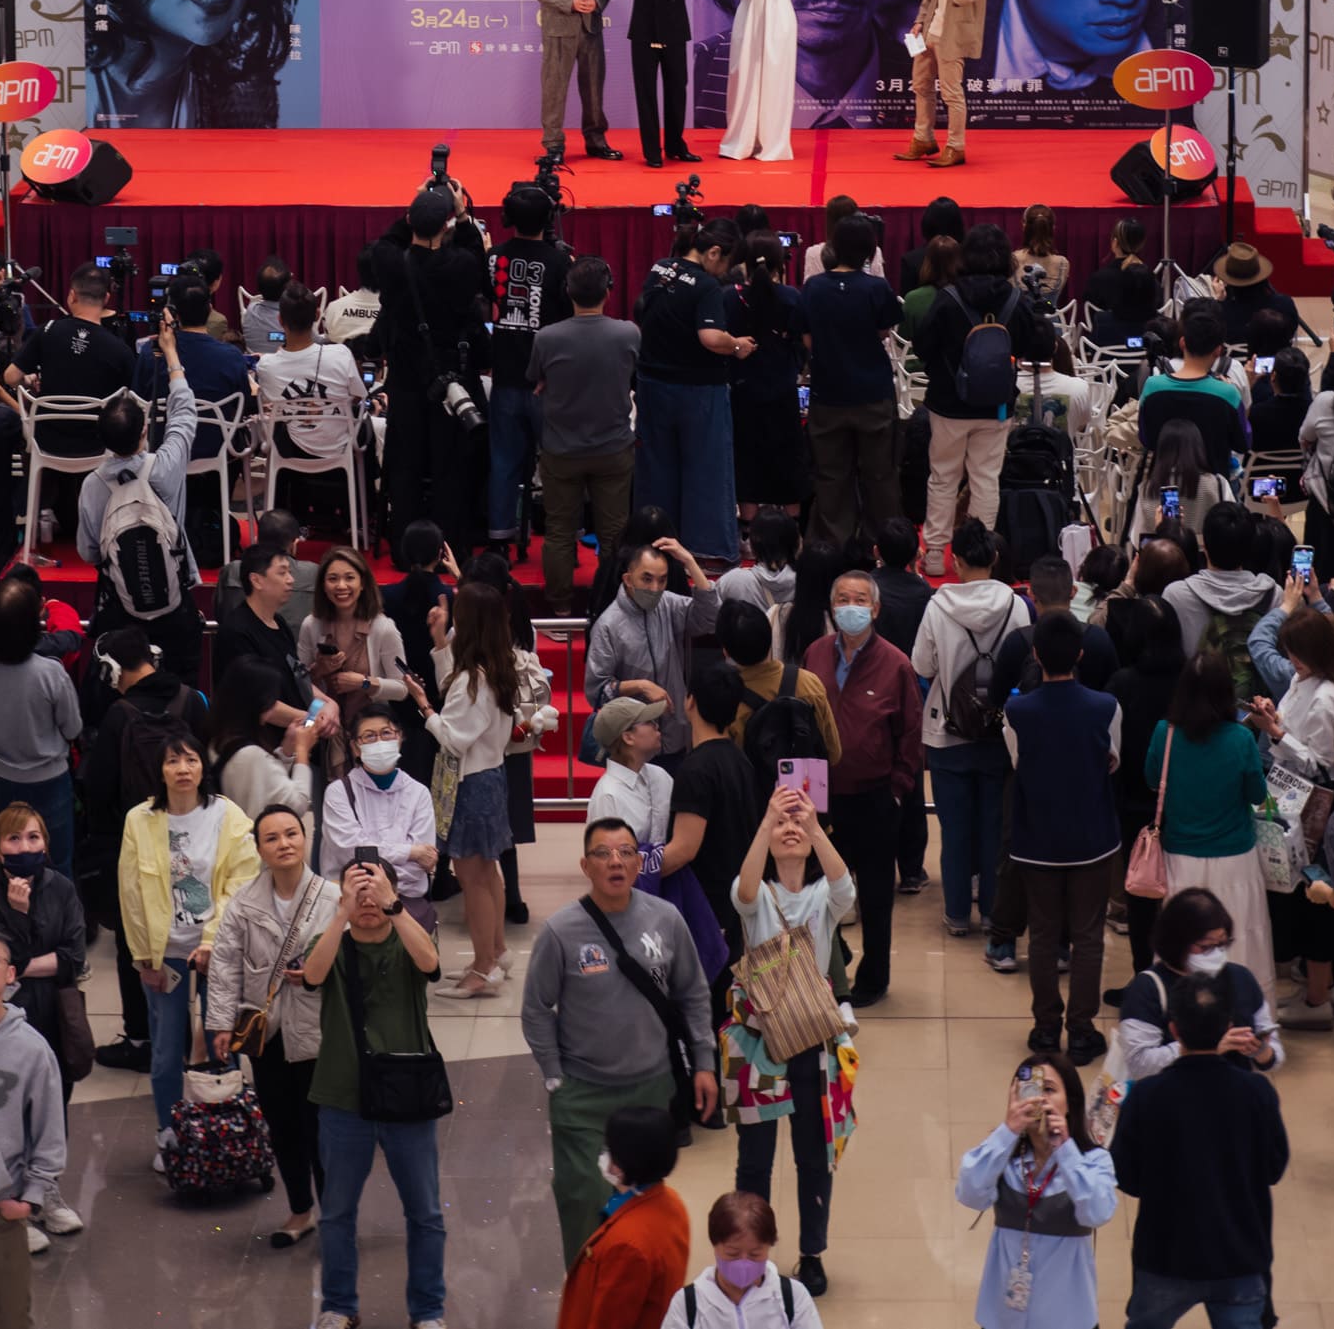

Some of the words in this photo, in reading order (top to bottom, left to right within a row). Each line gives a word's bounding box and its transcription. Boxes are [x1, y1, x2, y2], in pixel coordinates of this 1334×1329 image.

[429, 41, 460, 54] apm
[1134, 67, 1195, 93] apm
[33, 143, 79, 170] apm
[1257, 179, 1298, 200] apm
[509, 258, 546, 286] 03
[528, 285, 543, 328] KONG
